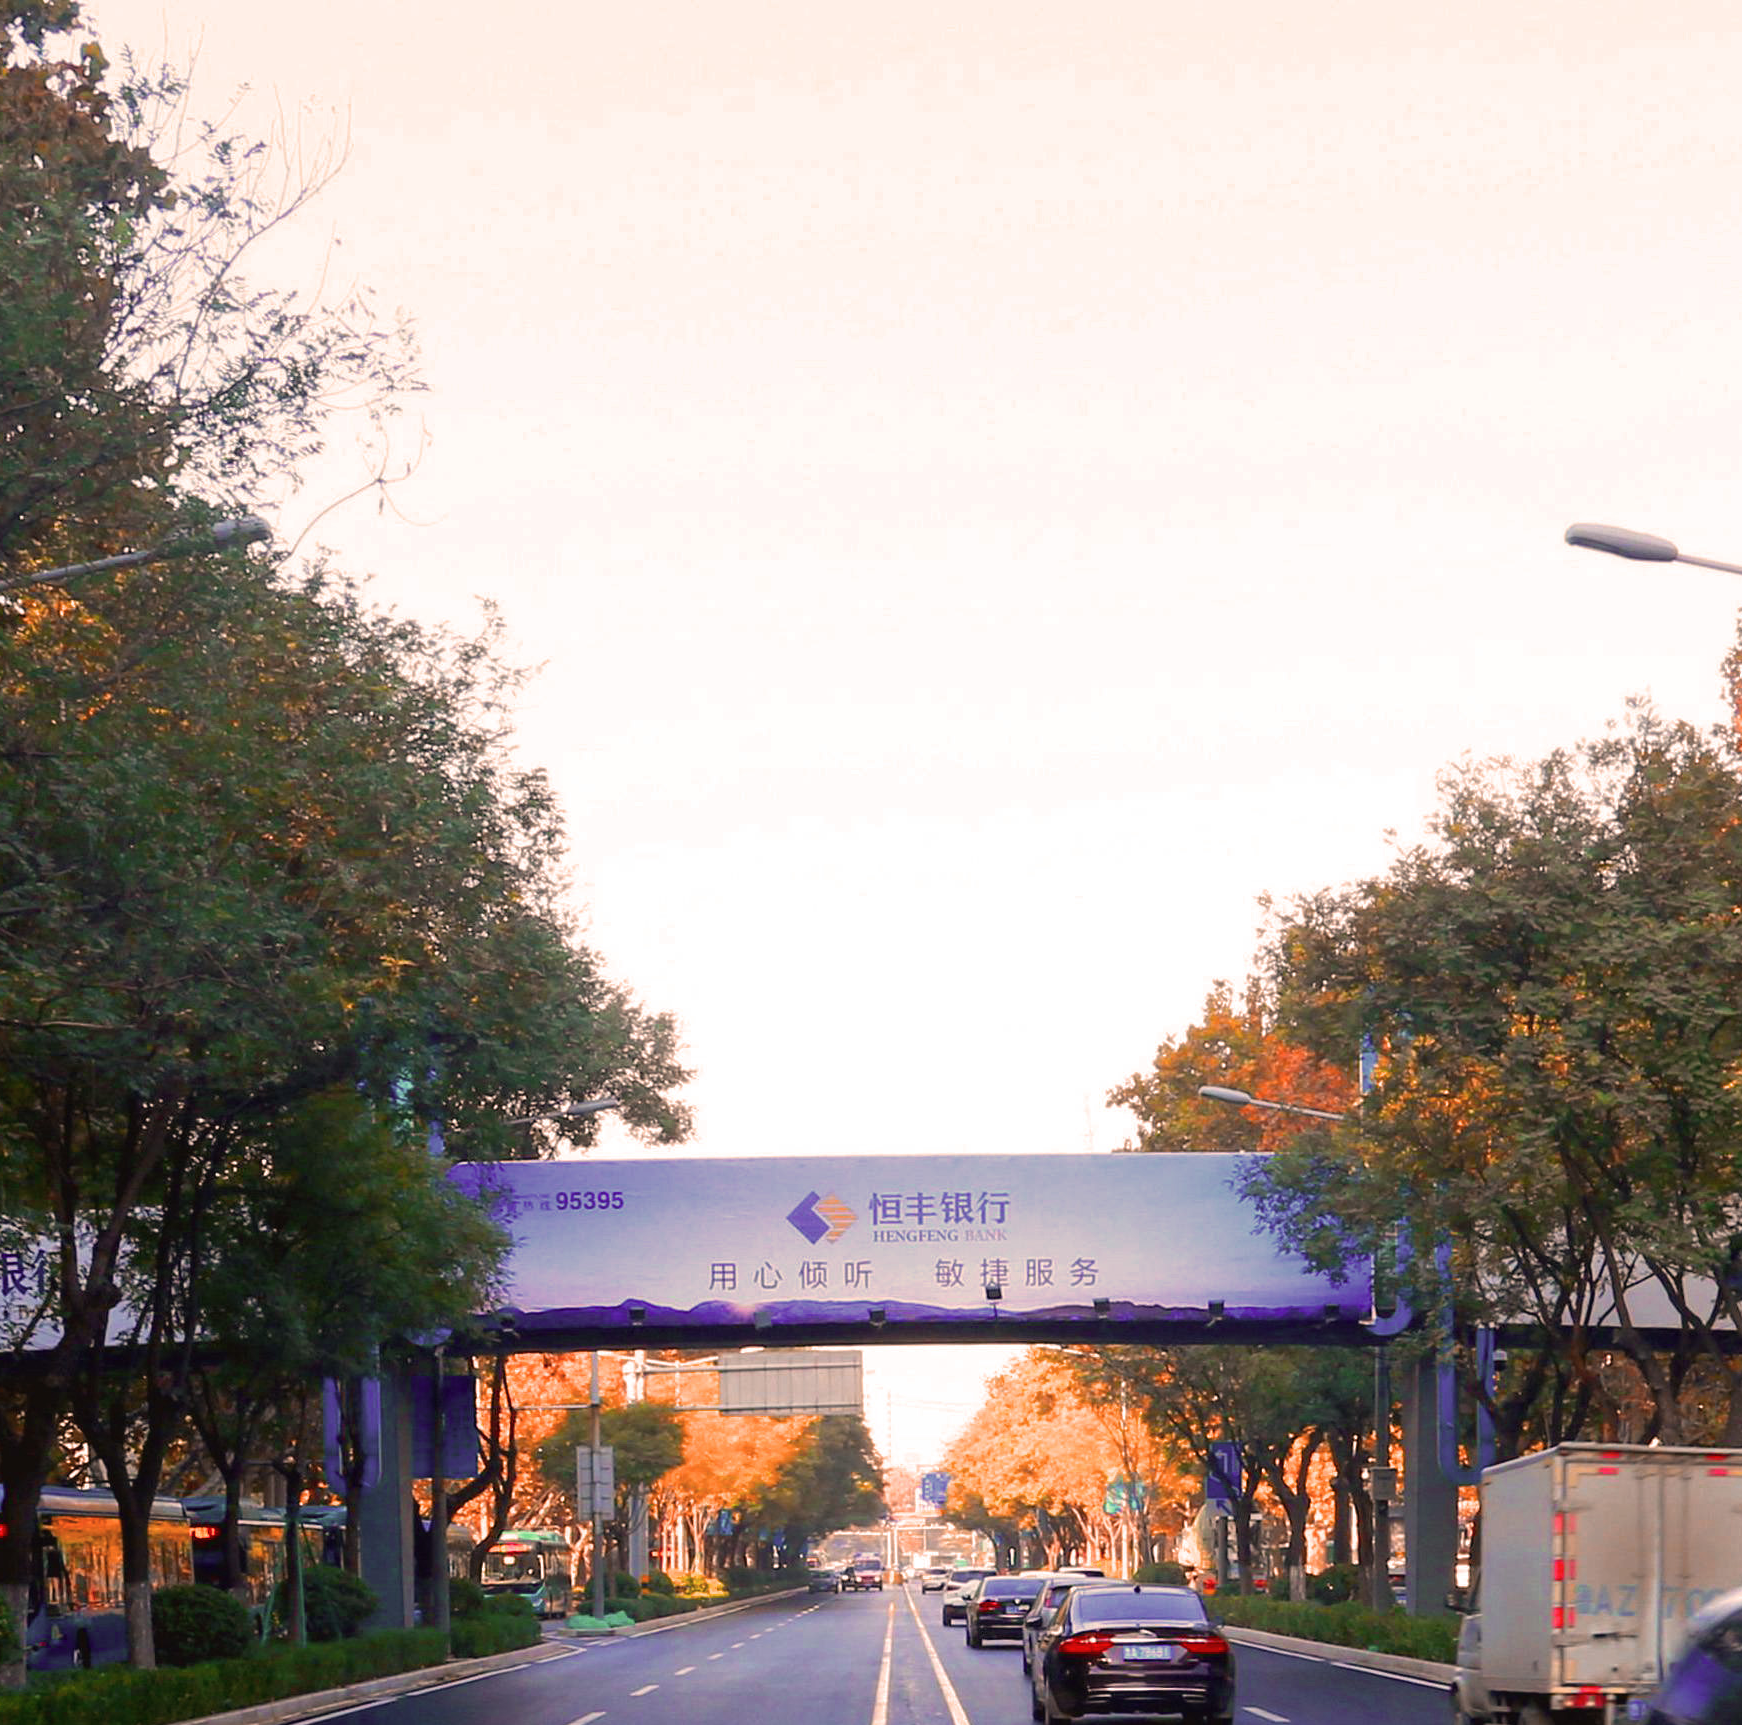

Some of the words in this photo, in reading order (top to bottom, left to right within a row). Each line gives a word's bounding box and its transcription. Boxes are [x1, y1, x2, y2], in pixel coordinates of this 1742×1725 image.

[556, 1191, 624, 1210] 95395
[869, 1191, 1010, 1225] 恒丰银行
[873, 1229, 958, 1242] HENGFENG
[964, 1229, 1007, 1241] BANK
[709, 1260, 873, 1290] 用心倾听
[935, 1258, 1100, 1288] 敏捷服务
